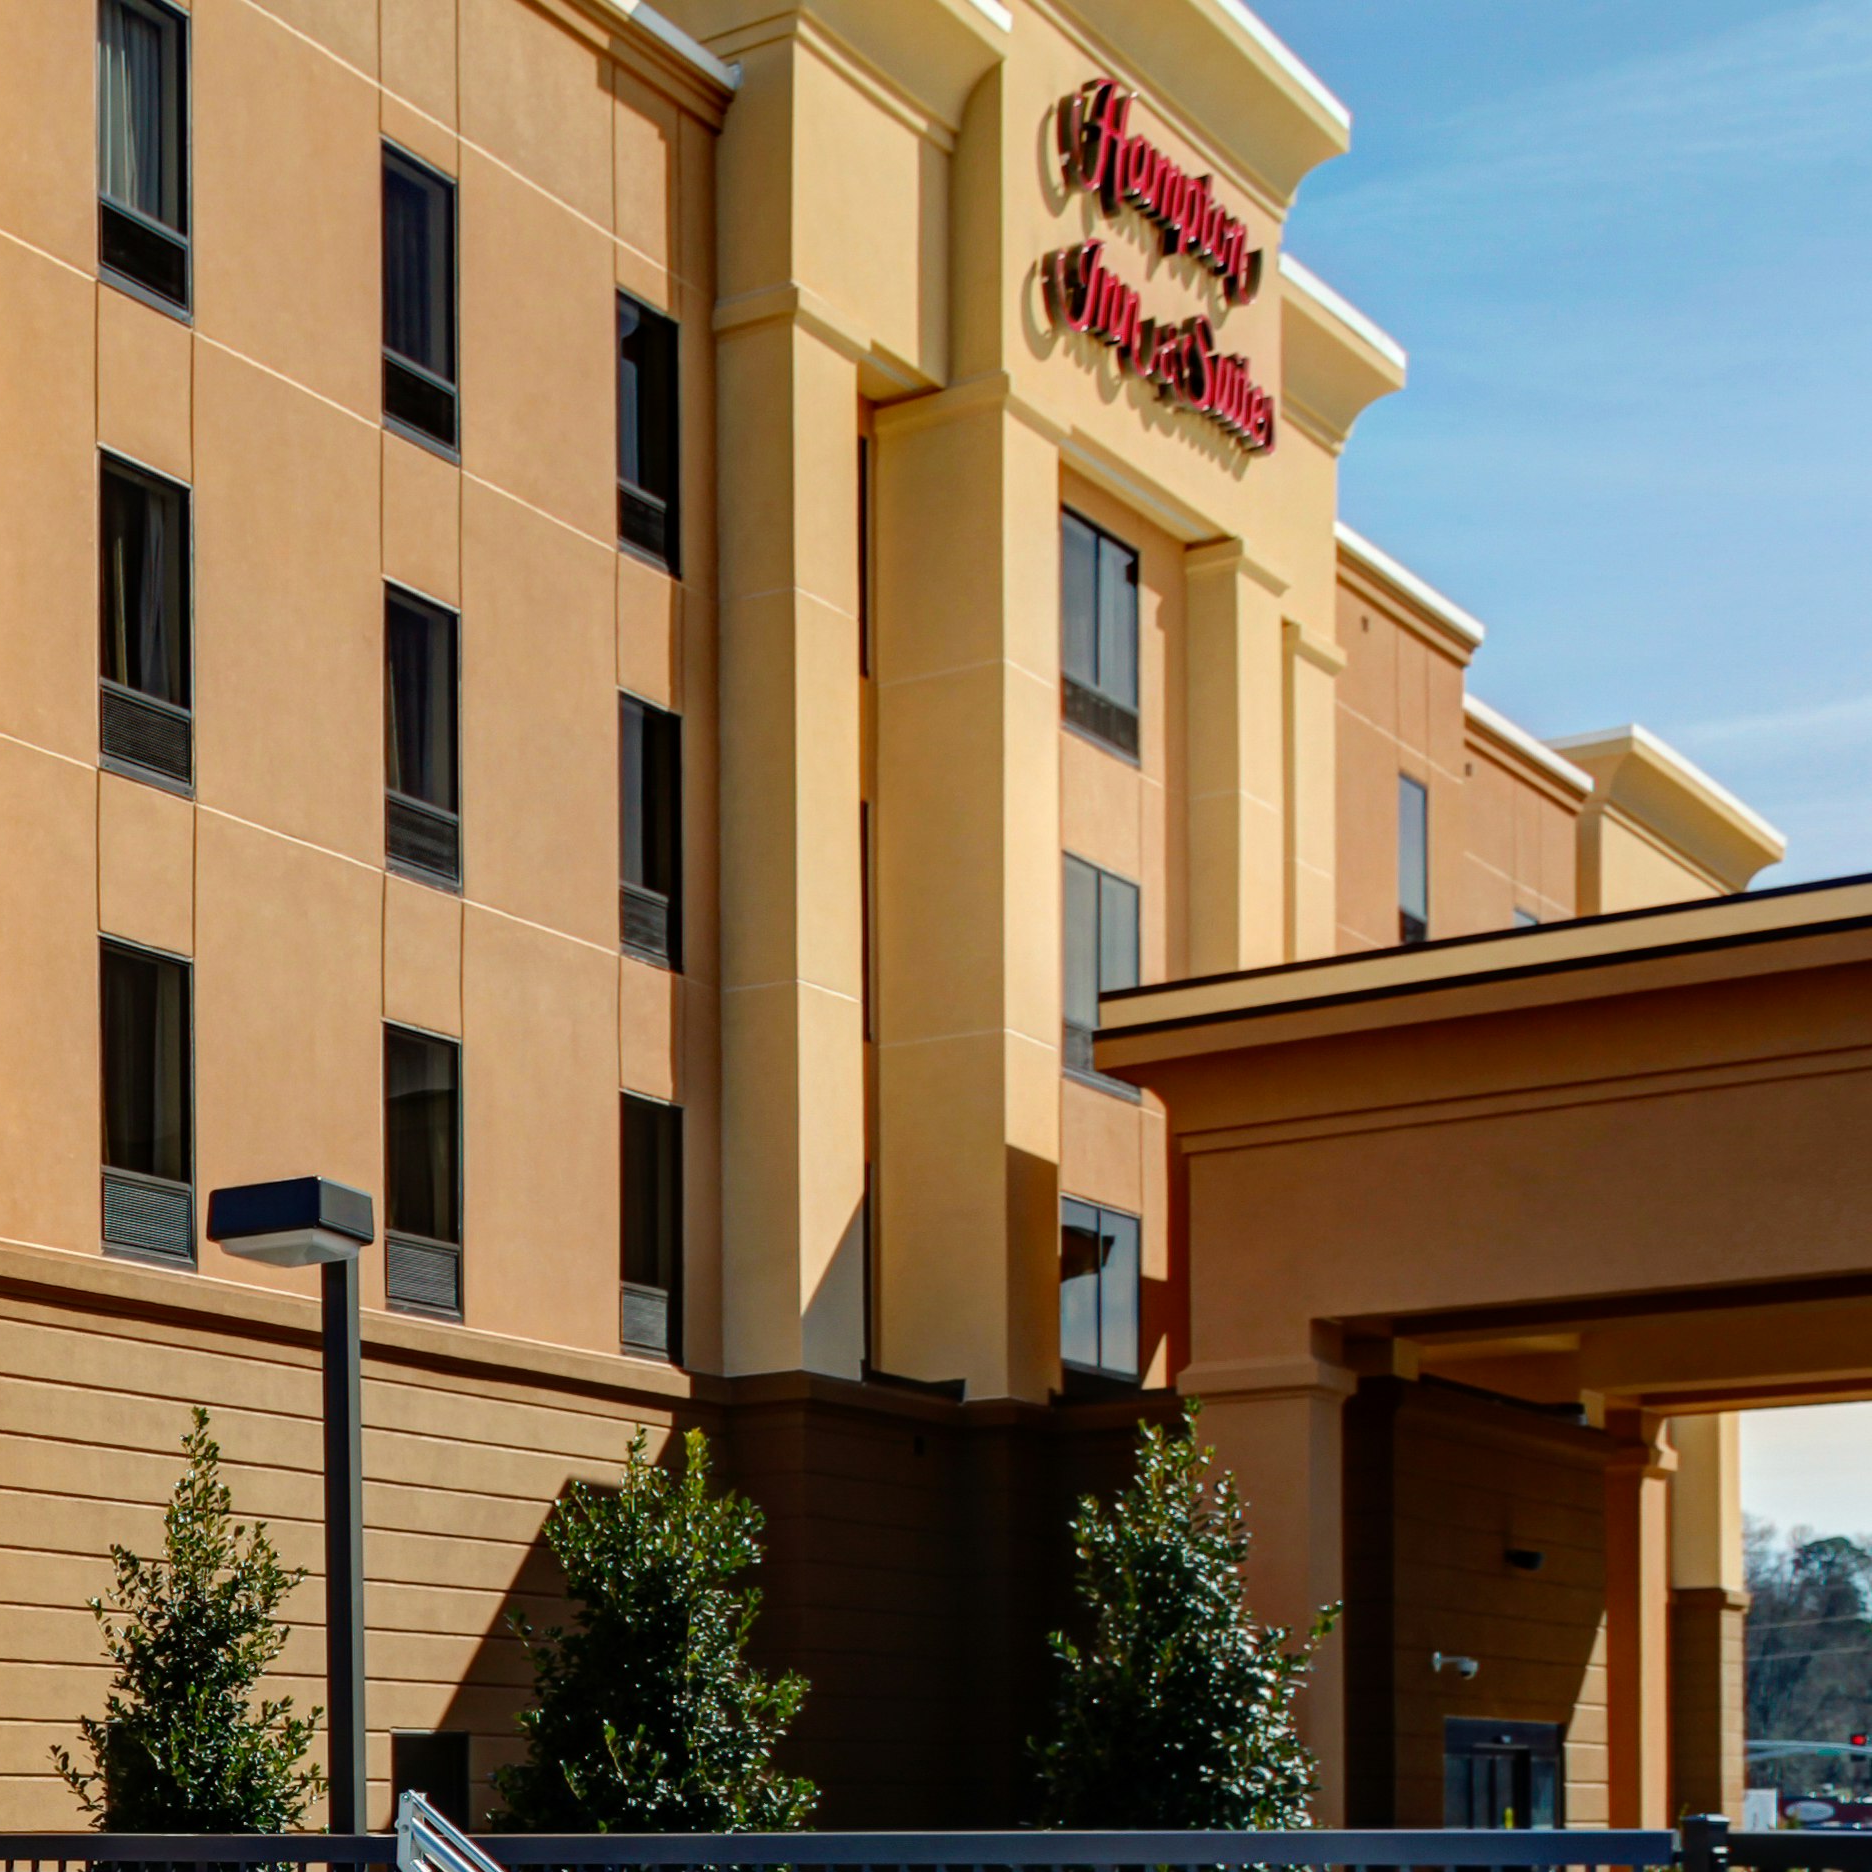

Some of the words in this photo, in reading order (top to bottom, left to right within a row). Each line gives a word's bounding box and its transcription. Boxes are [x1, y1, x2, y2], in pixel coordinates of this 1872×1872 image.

[1057, 77, 1263, 305] Hampton
[1041, 237, 1160, 378] Inn
[1183, 314, 1276, 455] Suites
